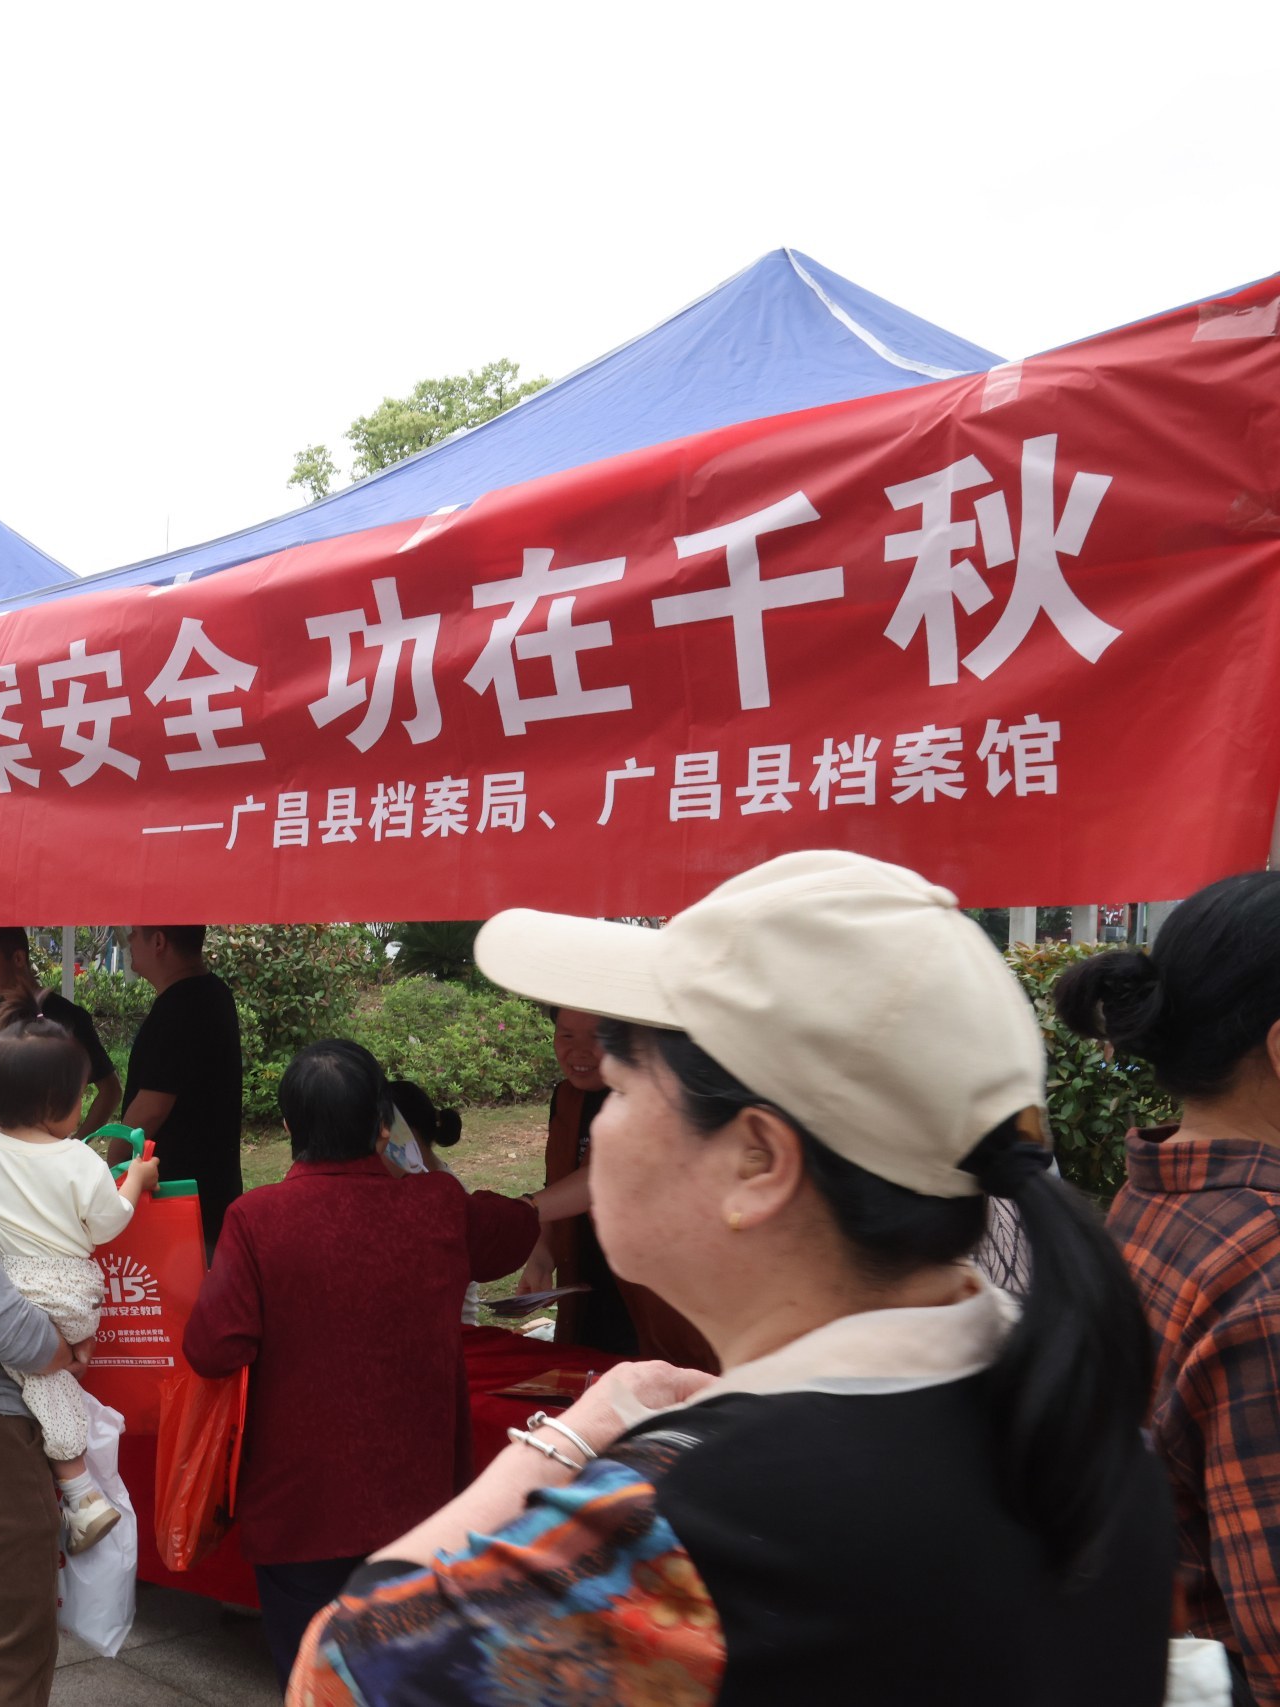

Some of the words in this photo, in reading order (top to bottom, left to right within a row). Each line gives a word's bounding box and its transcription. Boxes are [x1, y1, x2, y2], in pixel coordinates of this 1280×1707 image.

[306, 432, 1124, 754] 功在千秋
[141, 711, 1064, 852] ——广昌县档案局、广昌县档案馆
[102, 1276, 146, 1304] 15
